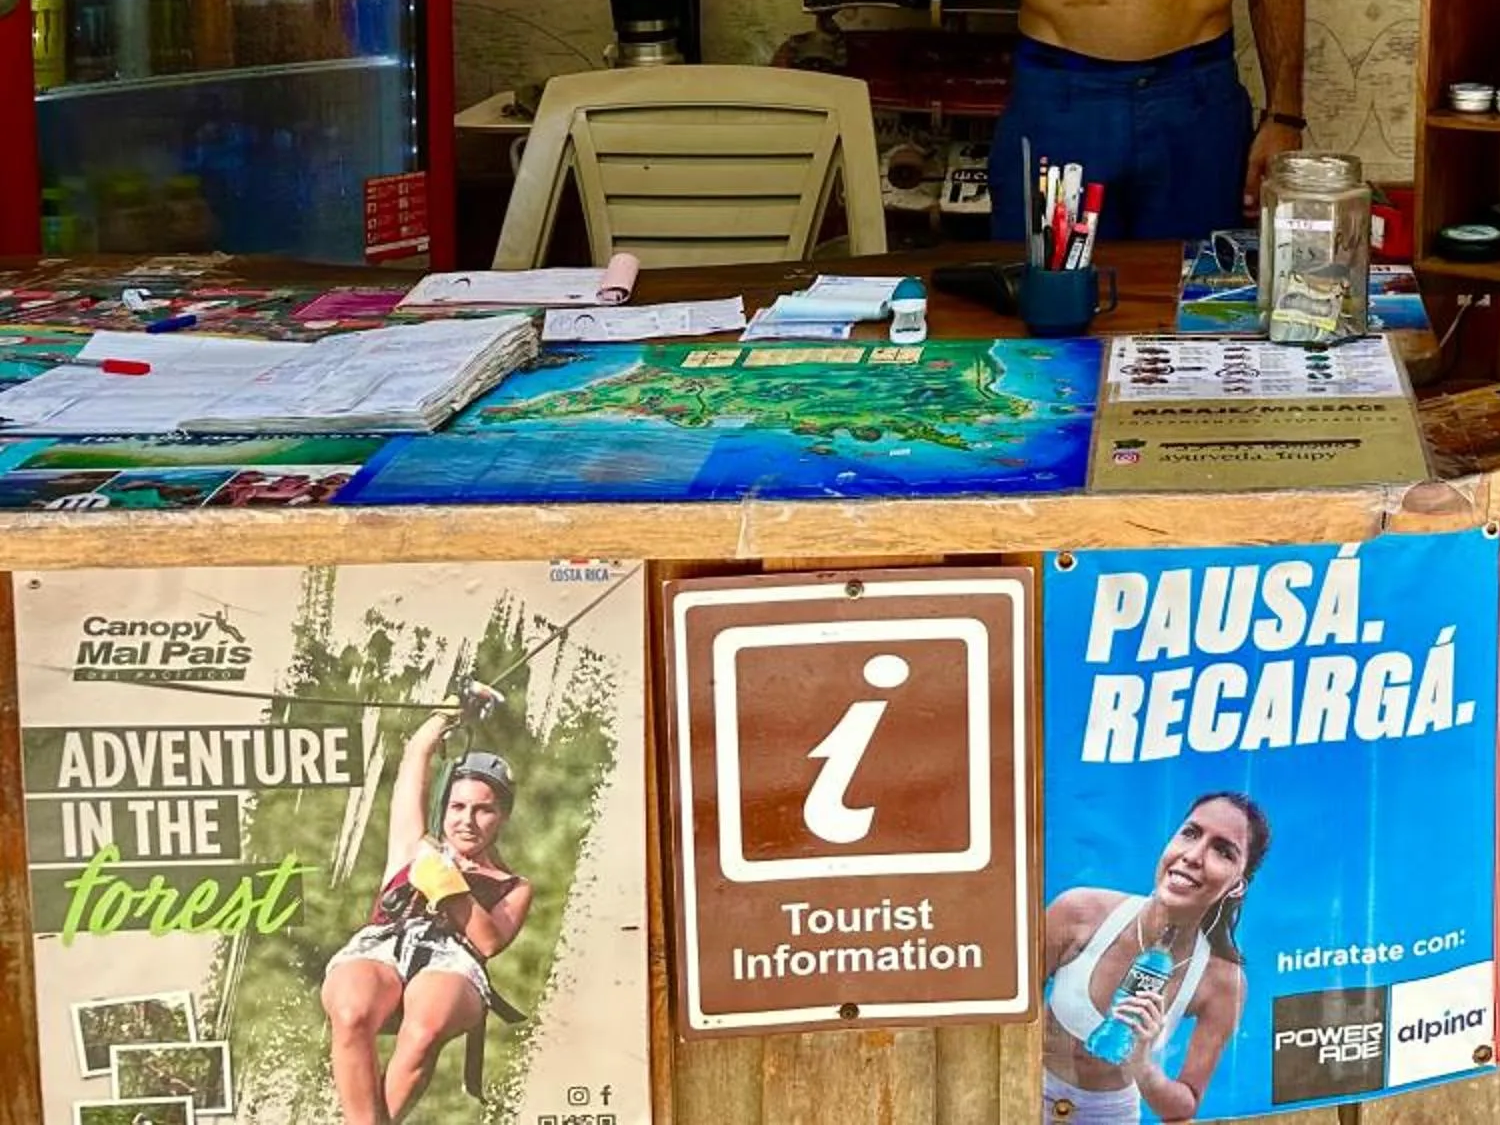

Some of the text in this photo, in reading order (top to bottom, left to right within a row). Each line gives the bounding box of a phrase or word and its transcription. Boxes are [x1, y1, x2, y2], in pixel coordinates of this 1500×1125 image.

[550, 568, 609, 582] COSTA RICA
[1085, 541, 1386, 663] PAUSÁ.
[84, 616, 213, 641] Canopy
[76, 639, 254, 665] Mal País
[1080, 624, 1477, 765] RECARGÁ.
[57, 727, 352, 789] ADVENTURE
[61, 797, 222, 858] IN THE
[61, 842, 321, 947] forest
[781, 898, 934, 935] Tourist
[732, 938, 983, 981] Information
[1277, 927, 1466, 974] hidratate con:
[1274, 1021, 1384, 1052] POWER
[1397, 1009, 1484, 1046] alpina
[1319, 1040, 1383, 1065] ADE
